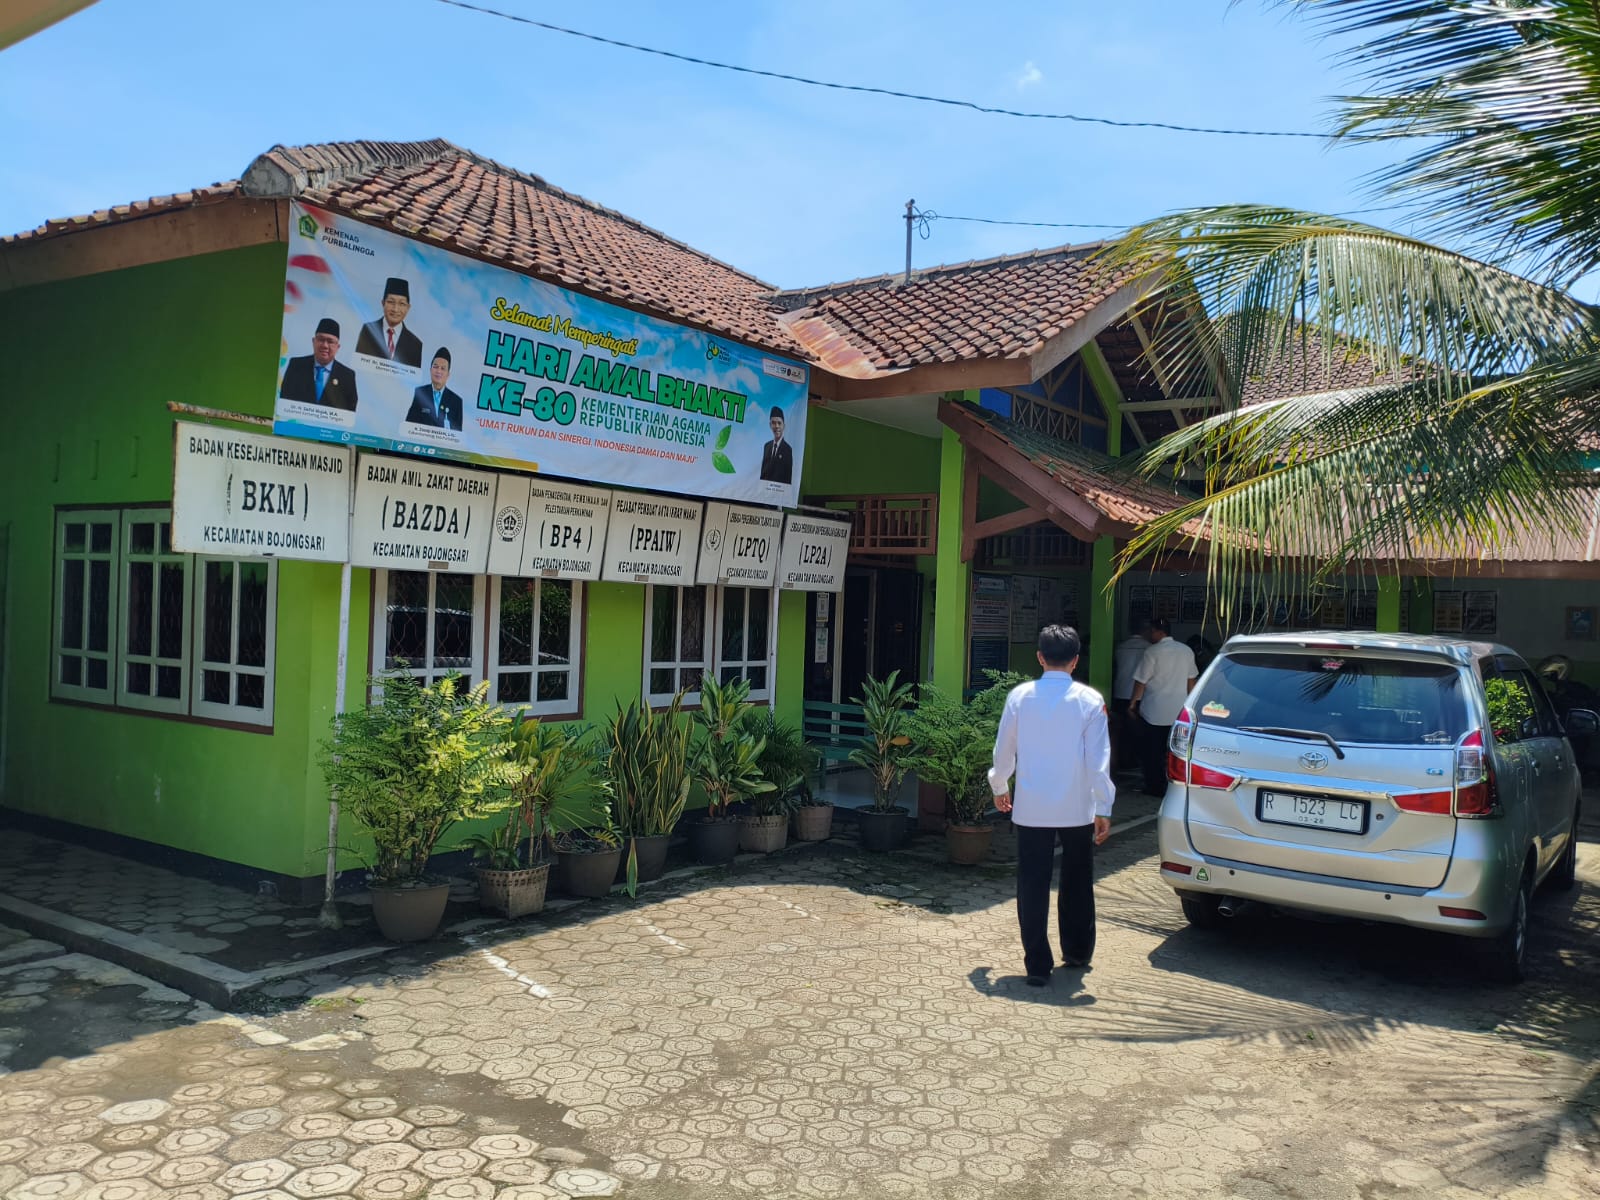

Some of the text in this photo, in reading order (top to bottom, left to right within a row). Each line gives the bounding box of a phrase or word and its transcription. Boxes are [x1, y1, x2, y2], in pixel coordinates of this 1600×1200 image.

[321, 235, 375, 256] PURBALINGGA
[490, 297, 639, 357] Selamat Memperingati
[484, 329, 748, 424] HARI AMAL BHAKTI
[477, 373, 577, 426] KE-80
[580, 411, 706, 448] REPUBLIK INDONESIA
[581, 396, 711, 435] KEMENTERIAN AGAMA
[507, 423, 537, 436] RUKUN
[538, 428, 556, 440] DAN
[594, 439, 636, 454] INDONESIA
[190, 437, 343, 474] BADAN KESEJAHTERAAN MASJID
[367, 465, 489, 496] BADAN AMIL ZAKAT DAERAH
[204, 526, 325, 551] KECAMATAN BOJONGSARI
[373, 542, 469, 562] KECAMATAN BOJONGSARI
[533, 557, 592, 573] KECAMATAN BOJONGSARI
[617, 561, 682, 577] KECAMATAN BOJONGSARI
[1265, 793, 1358, 820] R 1523 LC
